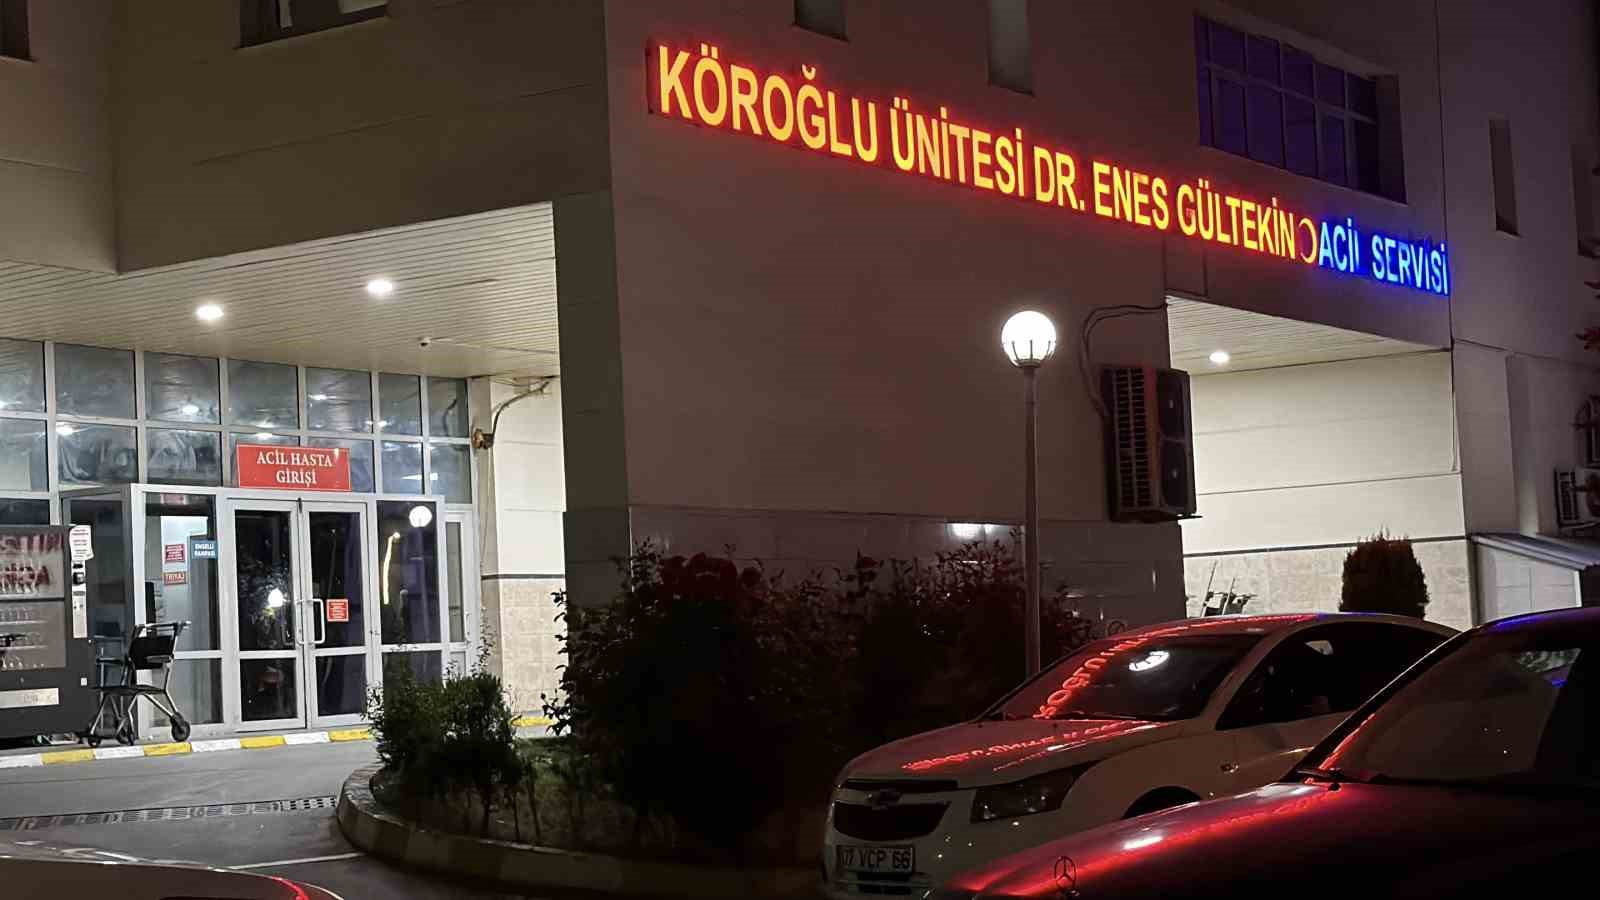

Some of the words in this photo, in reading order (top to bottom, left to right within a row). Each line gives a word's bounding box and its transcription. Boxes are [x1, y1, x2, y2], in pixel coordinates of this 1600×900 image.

[659, 43, 878, 162] KÖROĞLU
[890, 97, 1025, 197] ÜNİTESİ
[1033, 146, 1085, 211] DR.
[1092, 160, 1169, 230] ENES
[1177, 178, 1296, 259] GÜLTEKİN
[256, 449, 289, 465] ACİL
[291, 453, 333, 467] HASTA
[276, 468, 317, 487] GİRİŞİ
